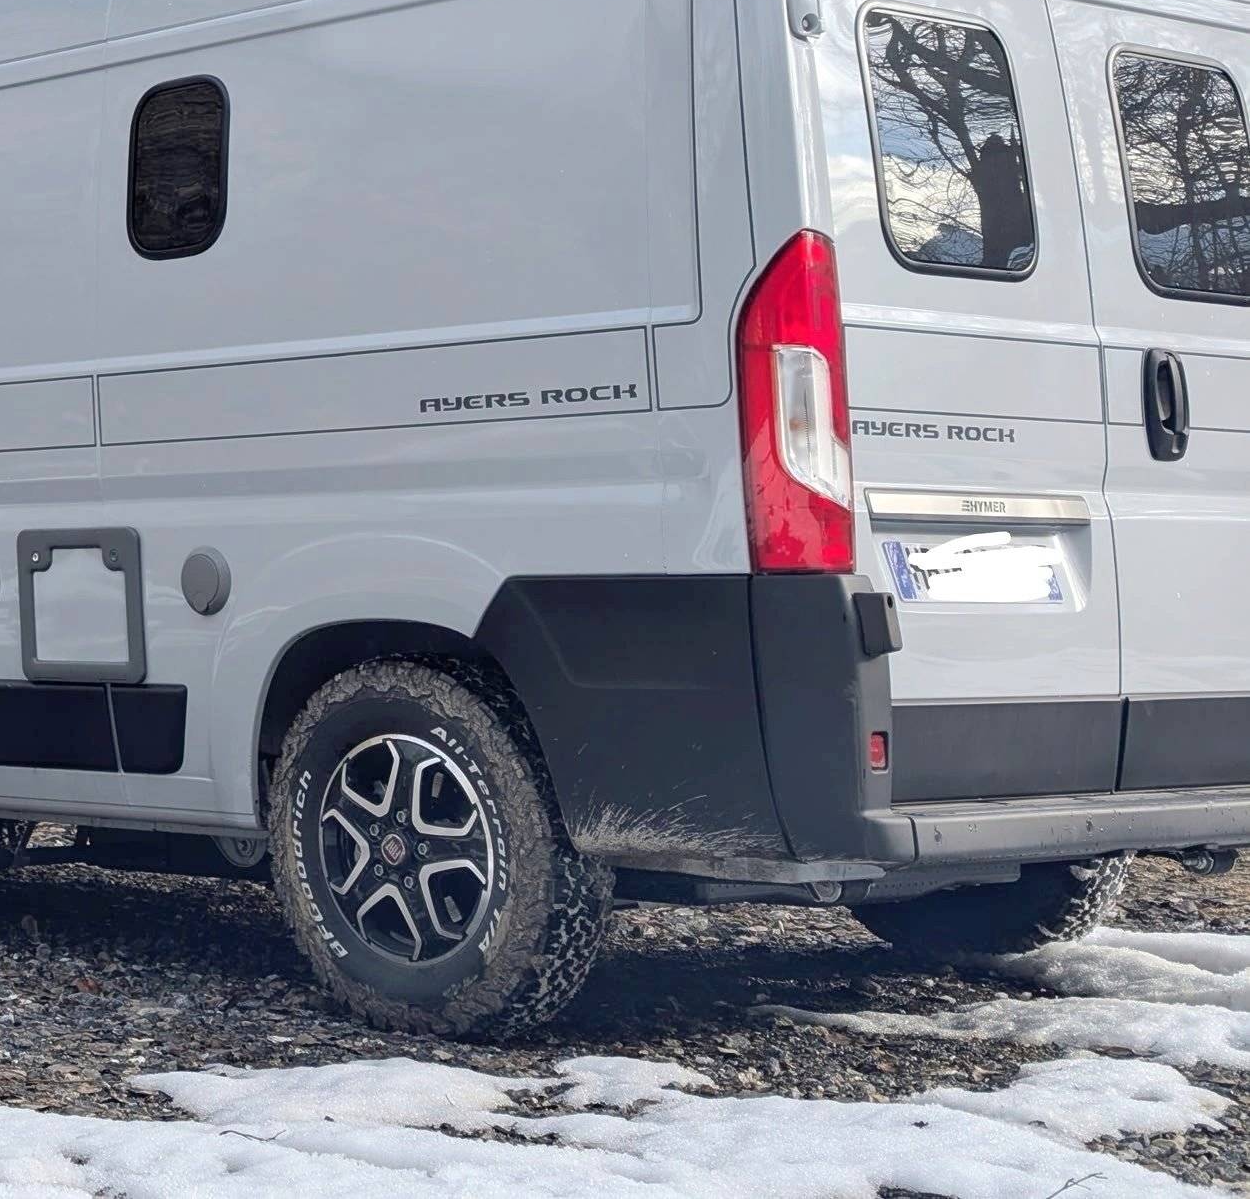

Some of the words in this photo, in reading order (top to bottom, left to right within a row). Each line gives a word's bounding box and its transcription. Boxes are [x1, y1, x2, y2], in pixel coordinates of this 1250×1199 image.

[419, 391, 530, 413] AYERS
[540, 383, 638, 405] ROCK
[851, 419, 940, 439] AYERS
[947, 424, 1015, 443] ROCK
[968, 500, 1006, 514] HYMER
[430, 726, 506, 891] All-Terrain
[291, 769, 349, 959] BFGoodrich
